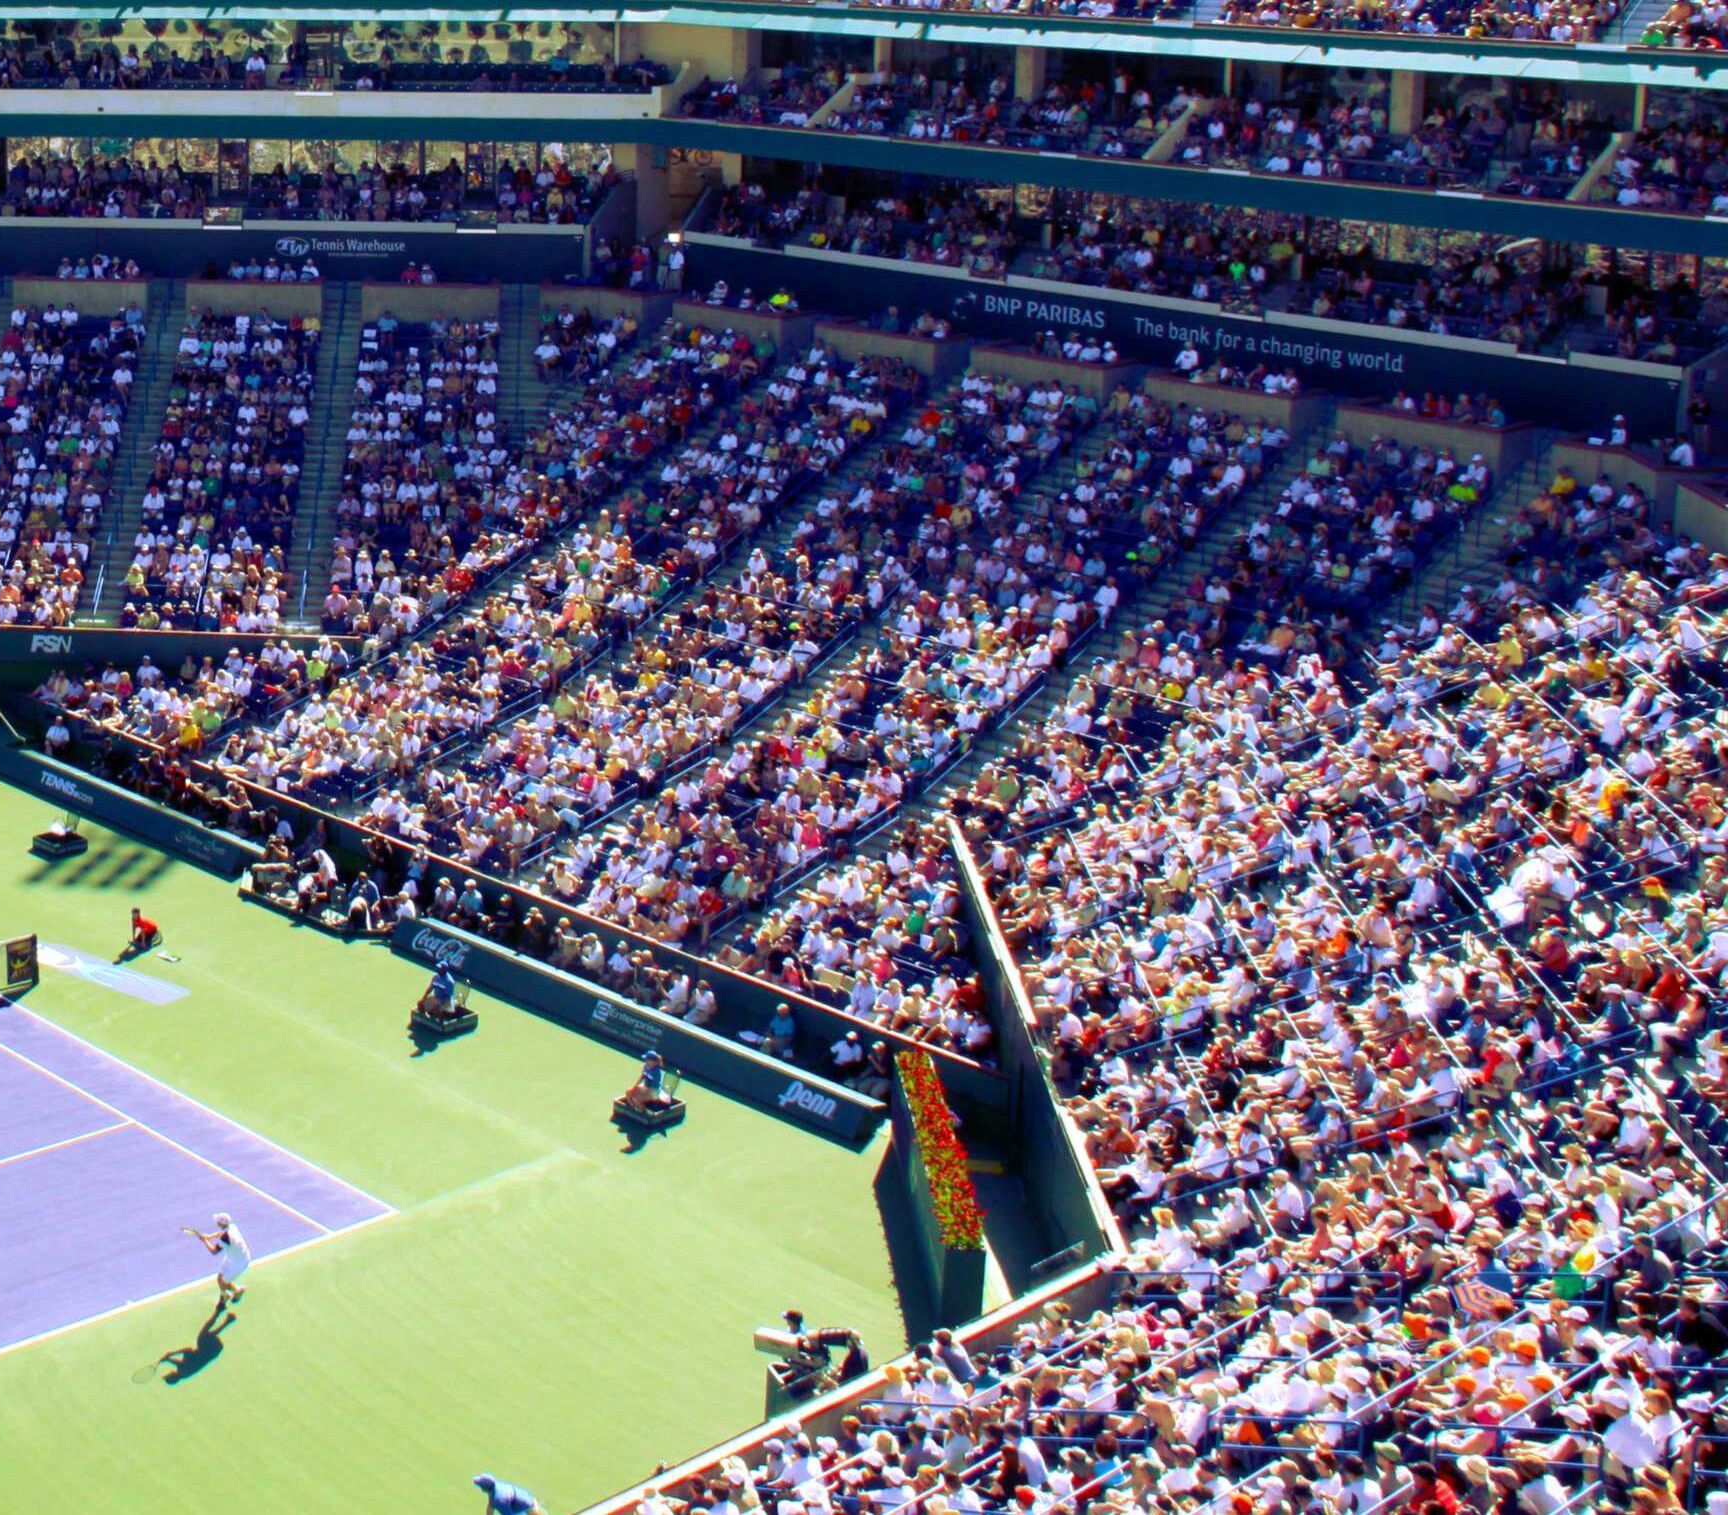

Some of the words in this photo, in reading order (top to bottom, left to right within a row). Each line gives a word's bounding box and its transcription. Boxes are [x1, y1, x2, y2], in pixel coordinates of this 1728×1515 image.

[312, 238, 345, 251] Tennis
[346, 239, 406, 252] Warehouse
[984, 295, 1022, 316] BNP
[1026, 300, 1105, 329] PARIBAS
[1133, 317, 1164, 338] The
[1168, 321, 1210, 345] bank
[1213, 328, 1241, 350] for
[1245, 337, 1257, 351] a
[1260, 335, 1343, 369] changing
[1347, 352, 1404, 373] world
[30, 633, 72, 653] FSN
